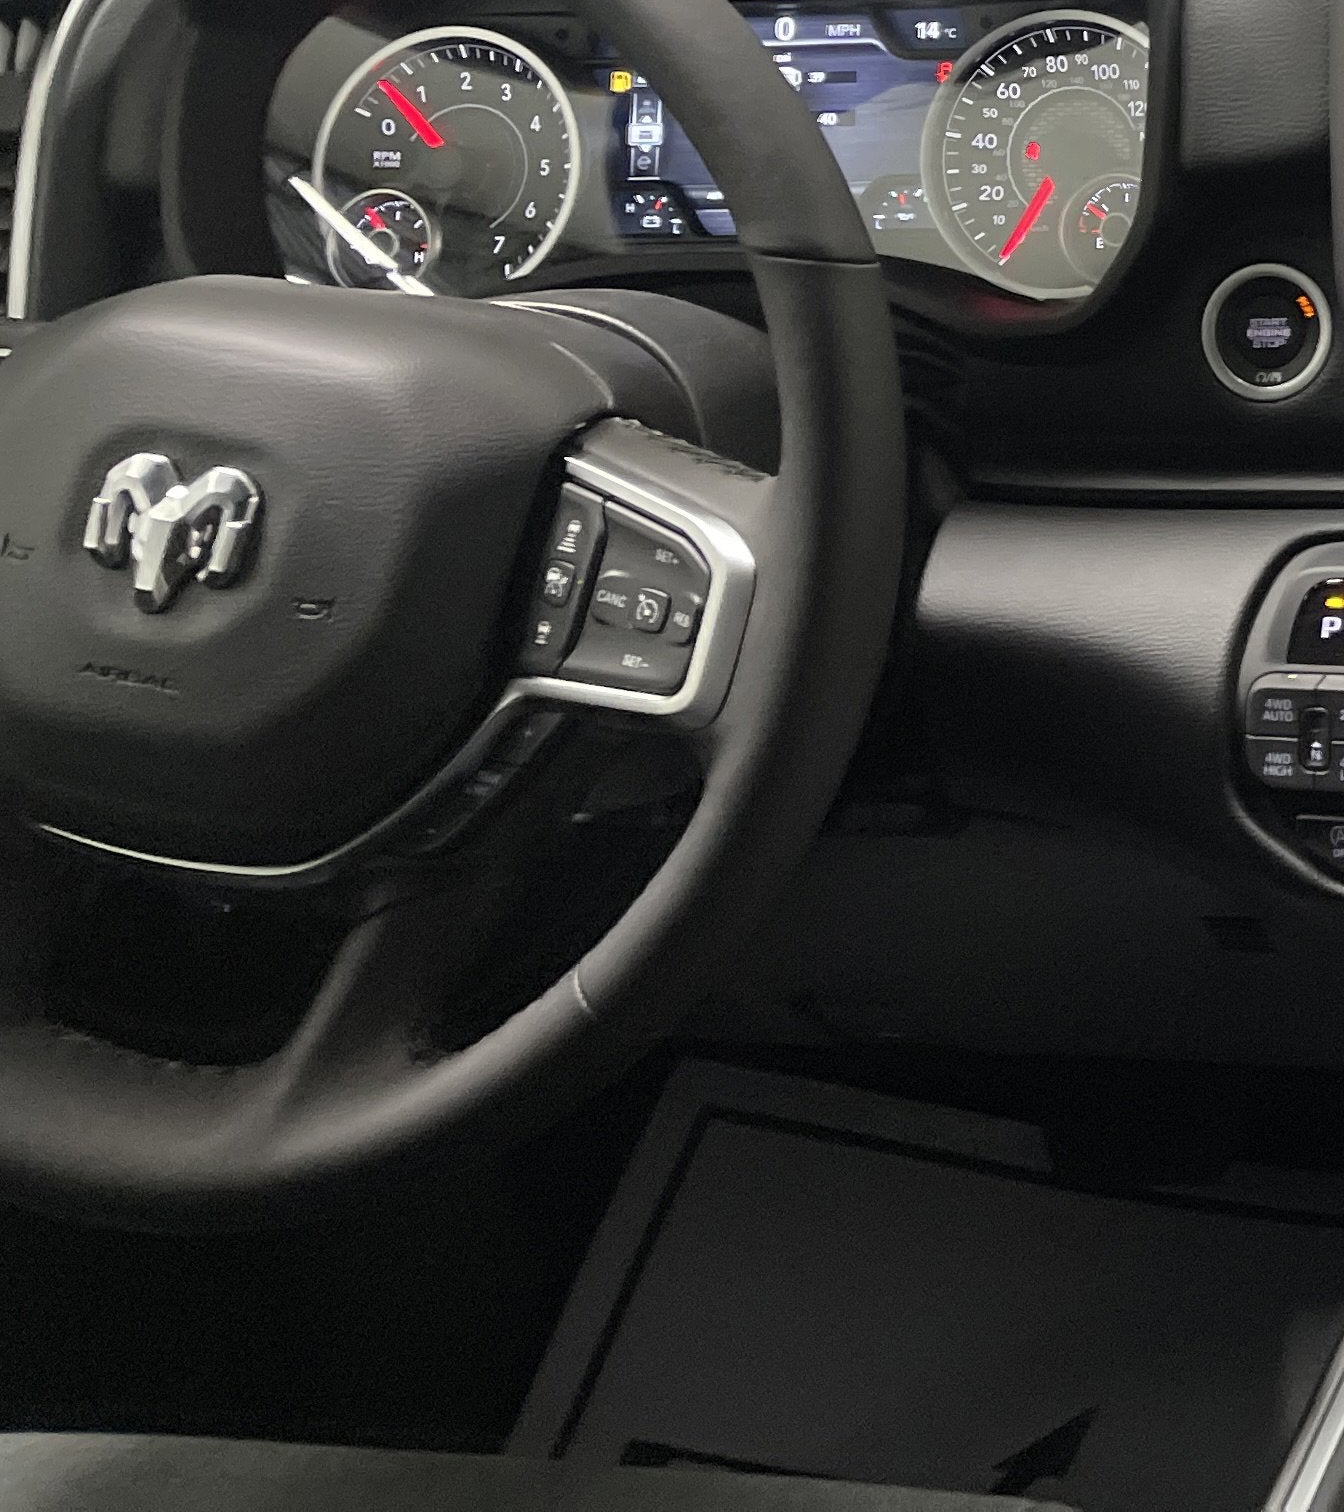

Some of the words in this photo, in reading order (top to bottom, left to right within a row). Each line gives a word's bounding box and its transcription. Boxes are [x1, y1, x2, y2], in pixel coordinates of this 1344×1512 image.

[775, 16, 795, 41] 0
[826, 23, 861, 38] MPH
[1045, 55, 1068, 73] 80
[1075, 54, 1089, 65] 90
[1021, 66, 1037, 78] 70
[1090, 63, 1120, 80] 100
[460, 72, 473, 90] 2
[1123, 80, 1139, 90] 110
[416, 85, 428, 102] 1
[501, 83, 512, 101] 3
[996, 83, 1021, 99] 60
[982, 108, 998, 119] 50
[1127, 101, 1146, 117] 12
[381, 119, 395, 135] 0
[530, 116, 541, 132] 4
[971, 133, 998, 149] 40
[539, 159, 550, 176] 5
[971, 164, 988, 174] 30
[978, 186, 1005, 201] 20
[525, 202, 536, 218] 6
[993, 215, 1006, 225] 10
[492, 236, 505, 253] 7
[1095, 238, 1104, 249] E
[414, 251, 424, 263] H
[1264, 698, 1292, 711] 4WD
[1262, 710, 1293, 722] AUTO
[1264, 752, 1292, 765] 4WD
[1263, 765, 1293, 777] HIGH
